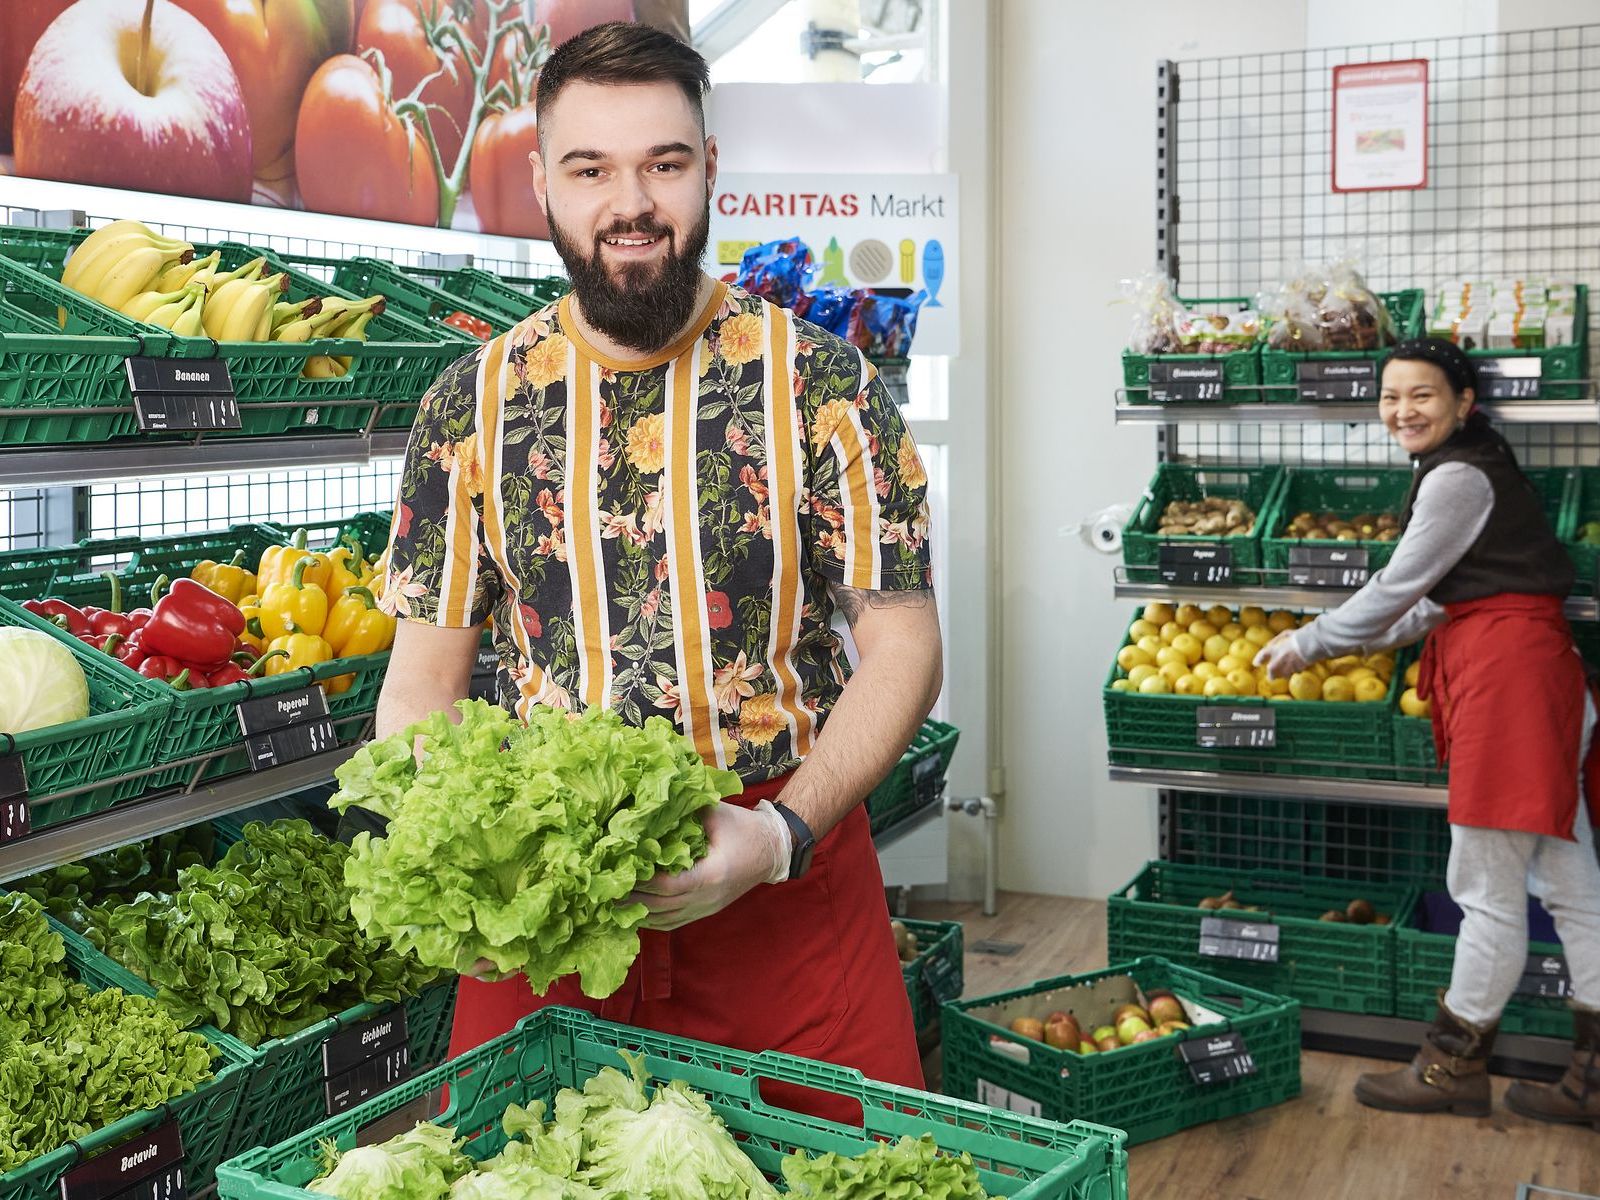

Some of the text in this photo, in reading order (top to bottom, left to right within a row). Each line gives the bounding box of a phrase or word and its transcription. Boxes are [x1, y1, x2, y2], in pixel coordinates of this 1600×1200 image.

[716, 192, 946, 218] CARITAS Markt
[174, 369, 210, 382] Bananen
[277, 694, 309, 713] Peperoni
[361, 1021, 392, 1045] Eichblatt
[120, 1143, 158, 1172] Batavia
